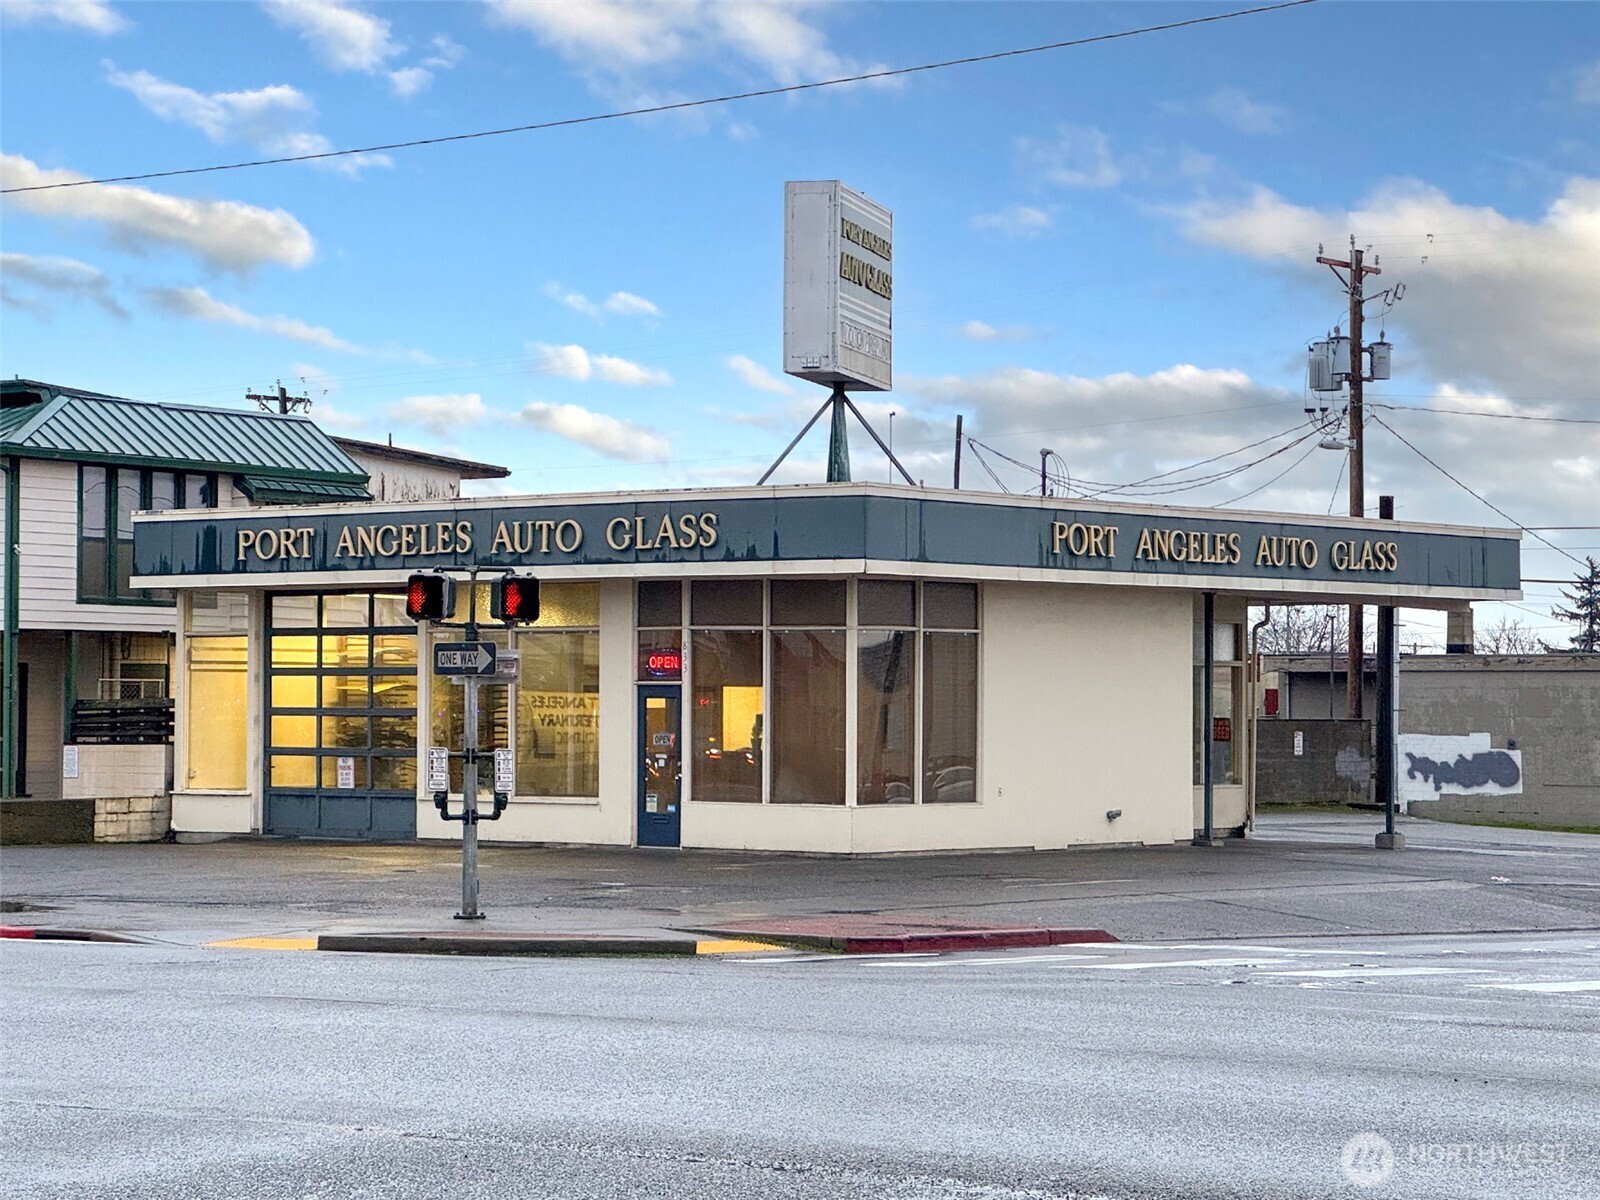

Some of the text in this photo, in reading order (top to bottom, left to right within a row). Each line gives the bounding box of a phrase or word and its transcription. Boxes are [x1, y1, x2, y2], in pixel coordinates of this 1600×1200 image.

[840, 252, 864, 286] AUTO
[237, 513, 718, 561] PORT ANGELES AUTO GLASS
[1052, 521, 1398, 571] PORT ANGELES AUTO GLASS
[440, 652, 479, 665] ONE WAY
[649, 655, 679, 668] OPEN
[654, 735, 671, 744] OPEN
